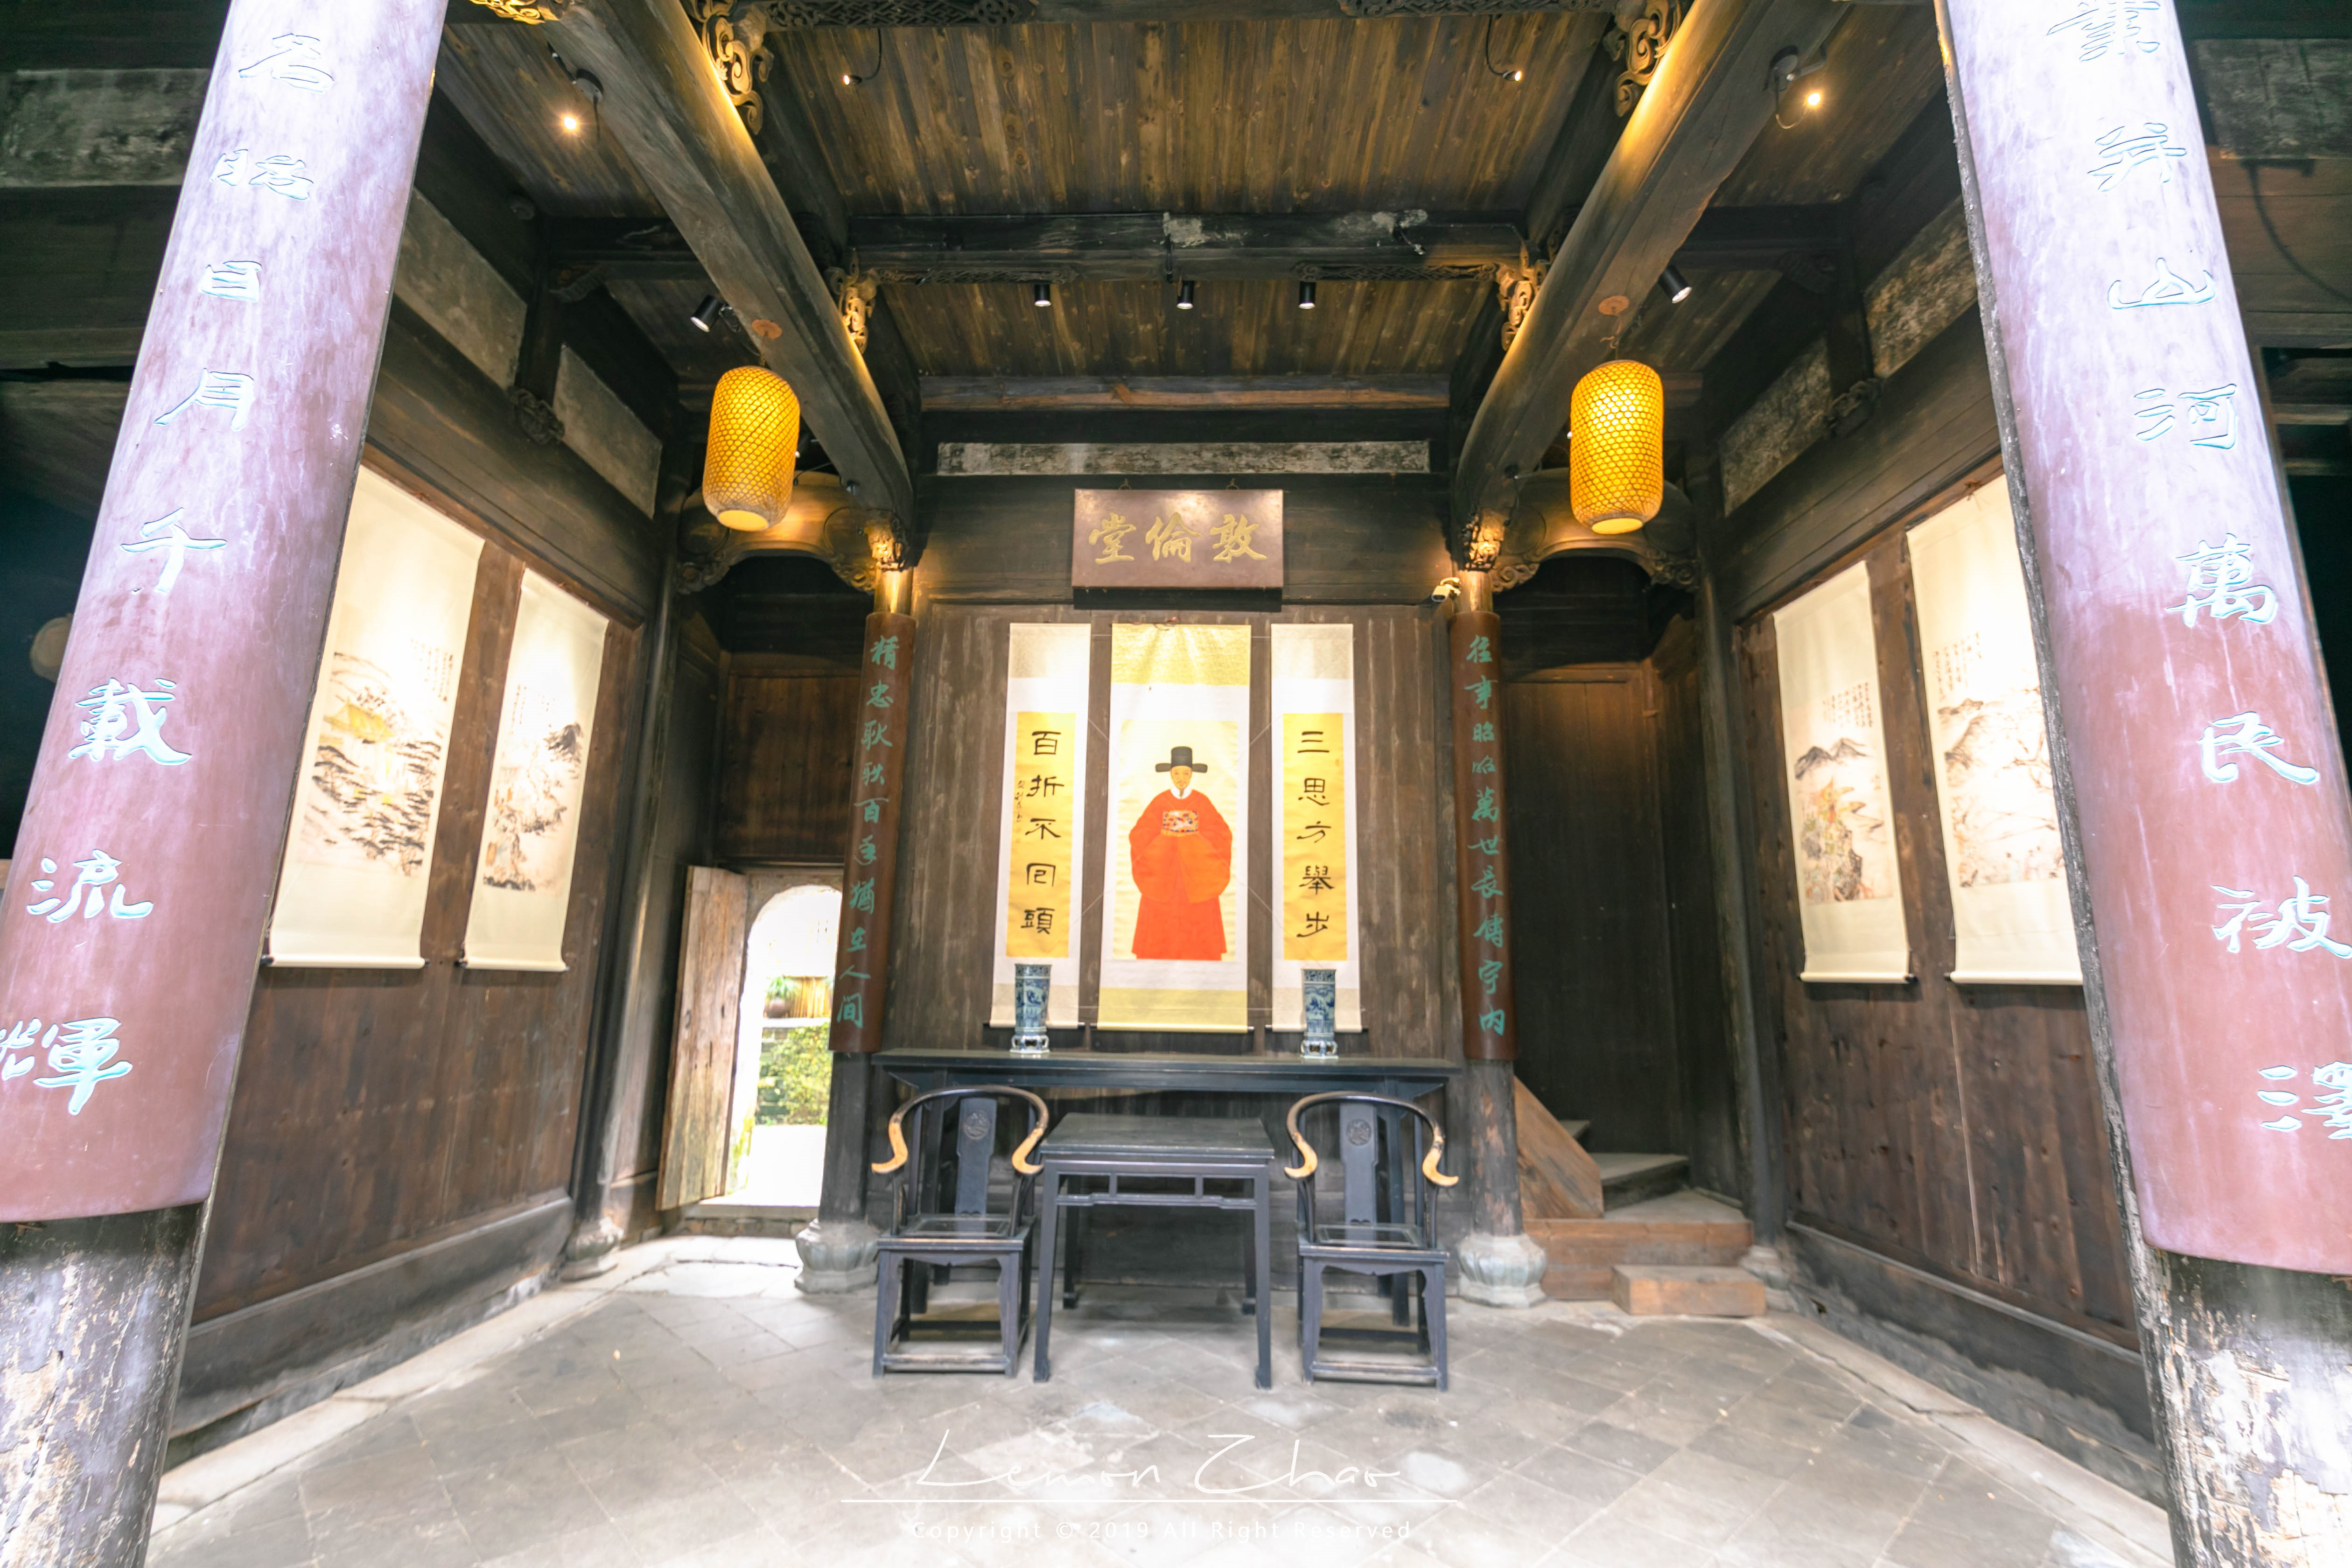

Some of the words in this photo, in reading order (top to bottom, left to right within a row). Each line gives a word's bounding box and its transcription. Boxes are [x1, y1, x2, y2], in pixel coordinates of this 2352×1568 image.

[1088, 512, 1267, 565] 敦倫堂
[1020, 730, 1064, 935] 百折不回頭
